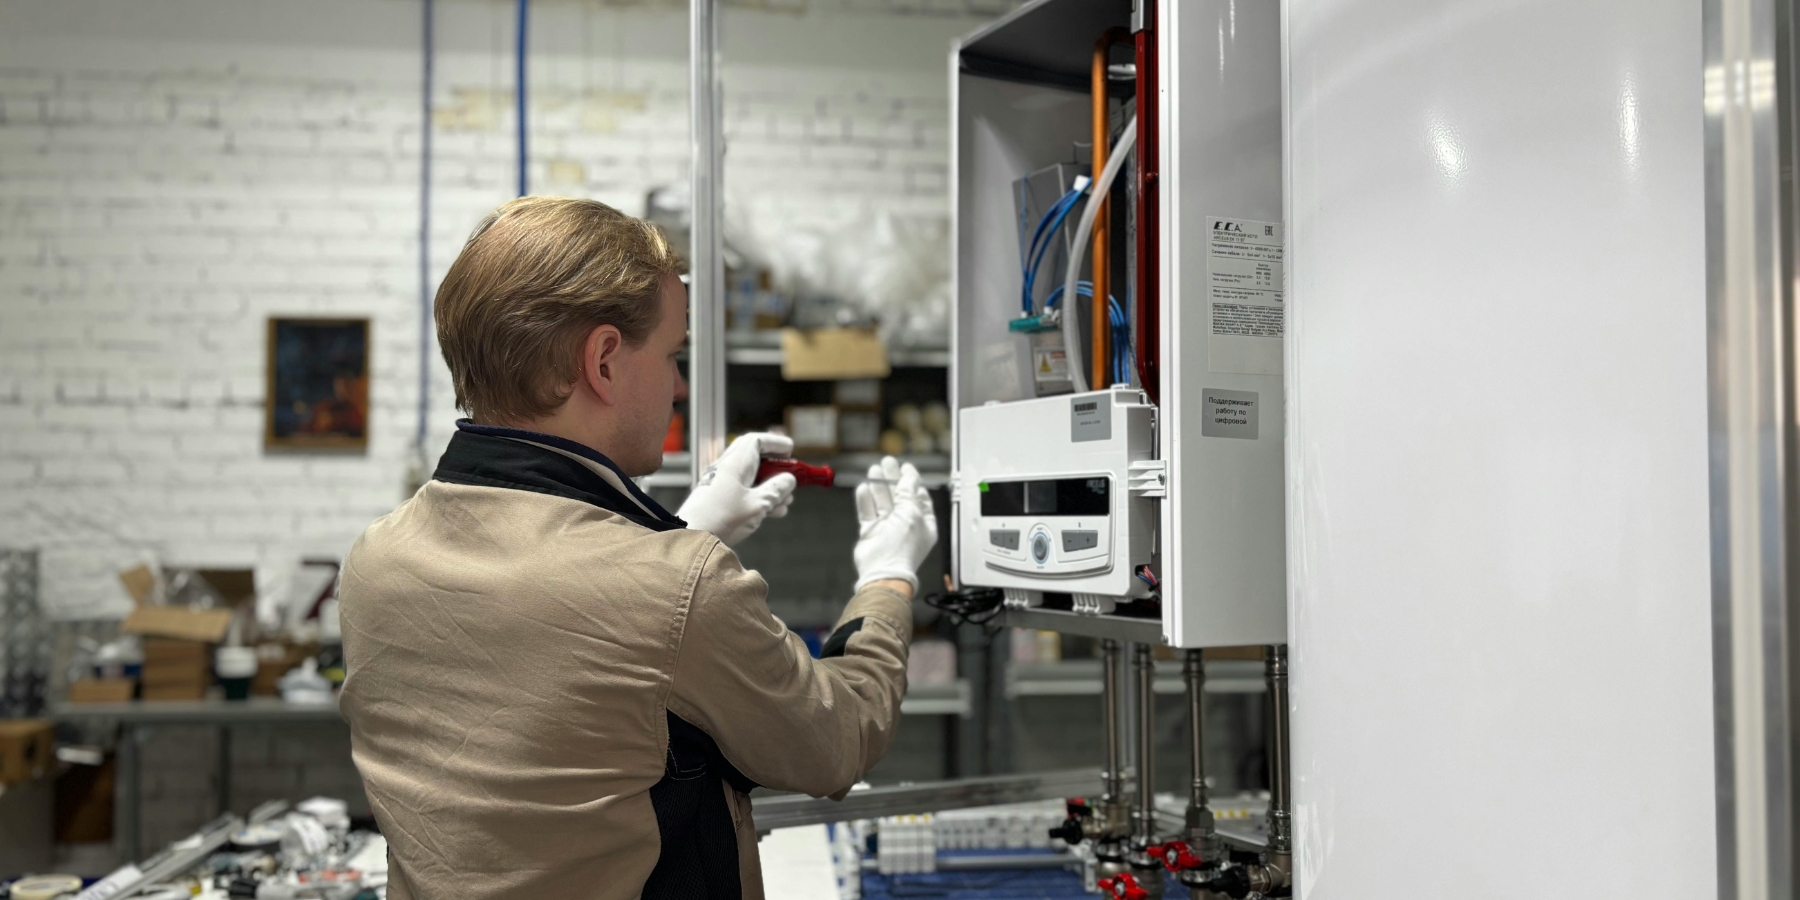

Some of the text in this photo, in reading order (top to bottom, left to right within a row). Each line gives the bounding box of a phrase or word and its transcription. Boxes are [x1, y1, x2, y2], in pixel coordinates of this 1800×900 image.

[1208, 396, 1254, 406] Поддерживает
[1215, 407, 1238, 416] работу
[1214, 417, 1248, 425] цифровой
